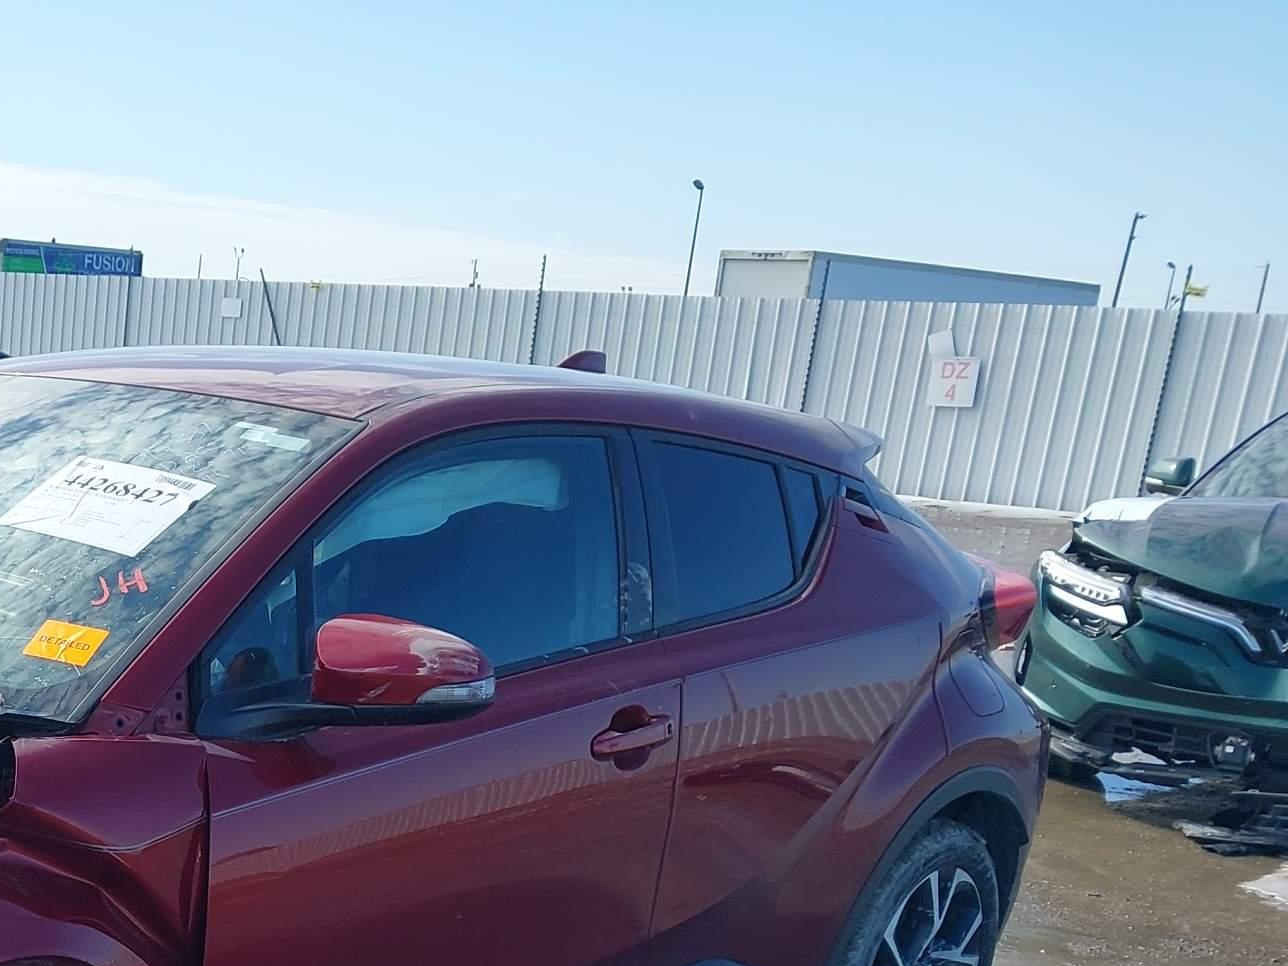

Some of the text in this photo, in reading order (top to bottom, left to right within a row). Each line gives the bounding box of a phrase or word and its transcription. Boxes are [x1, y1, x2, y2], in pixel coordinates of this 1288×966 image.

[84, 253, 135, 272] FUSION
[941, 361, 971, 379] DZ
[944, 384, 957, 401] 4
[64, 473, 182, 507] 44268427
[39, 634, 91, 651] DETAILED
